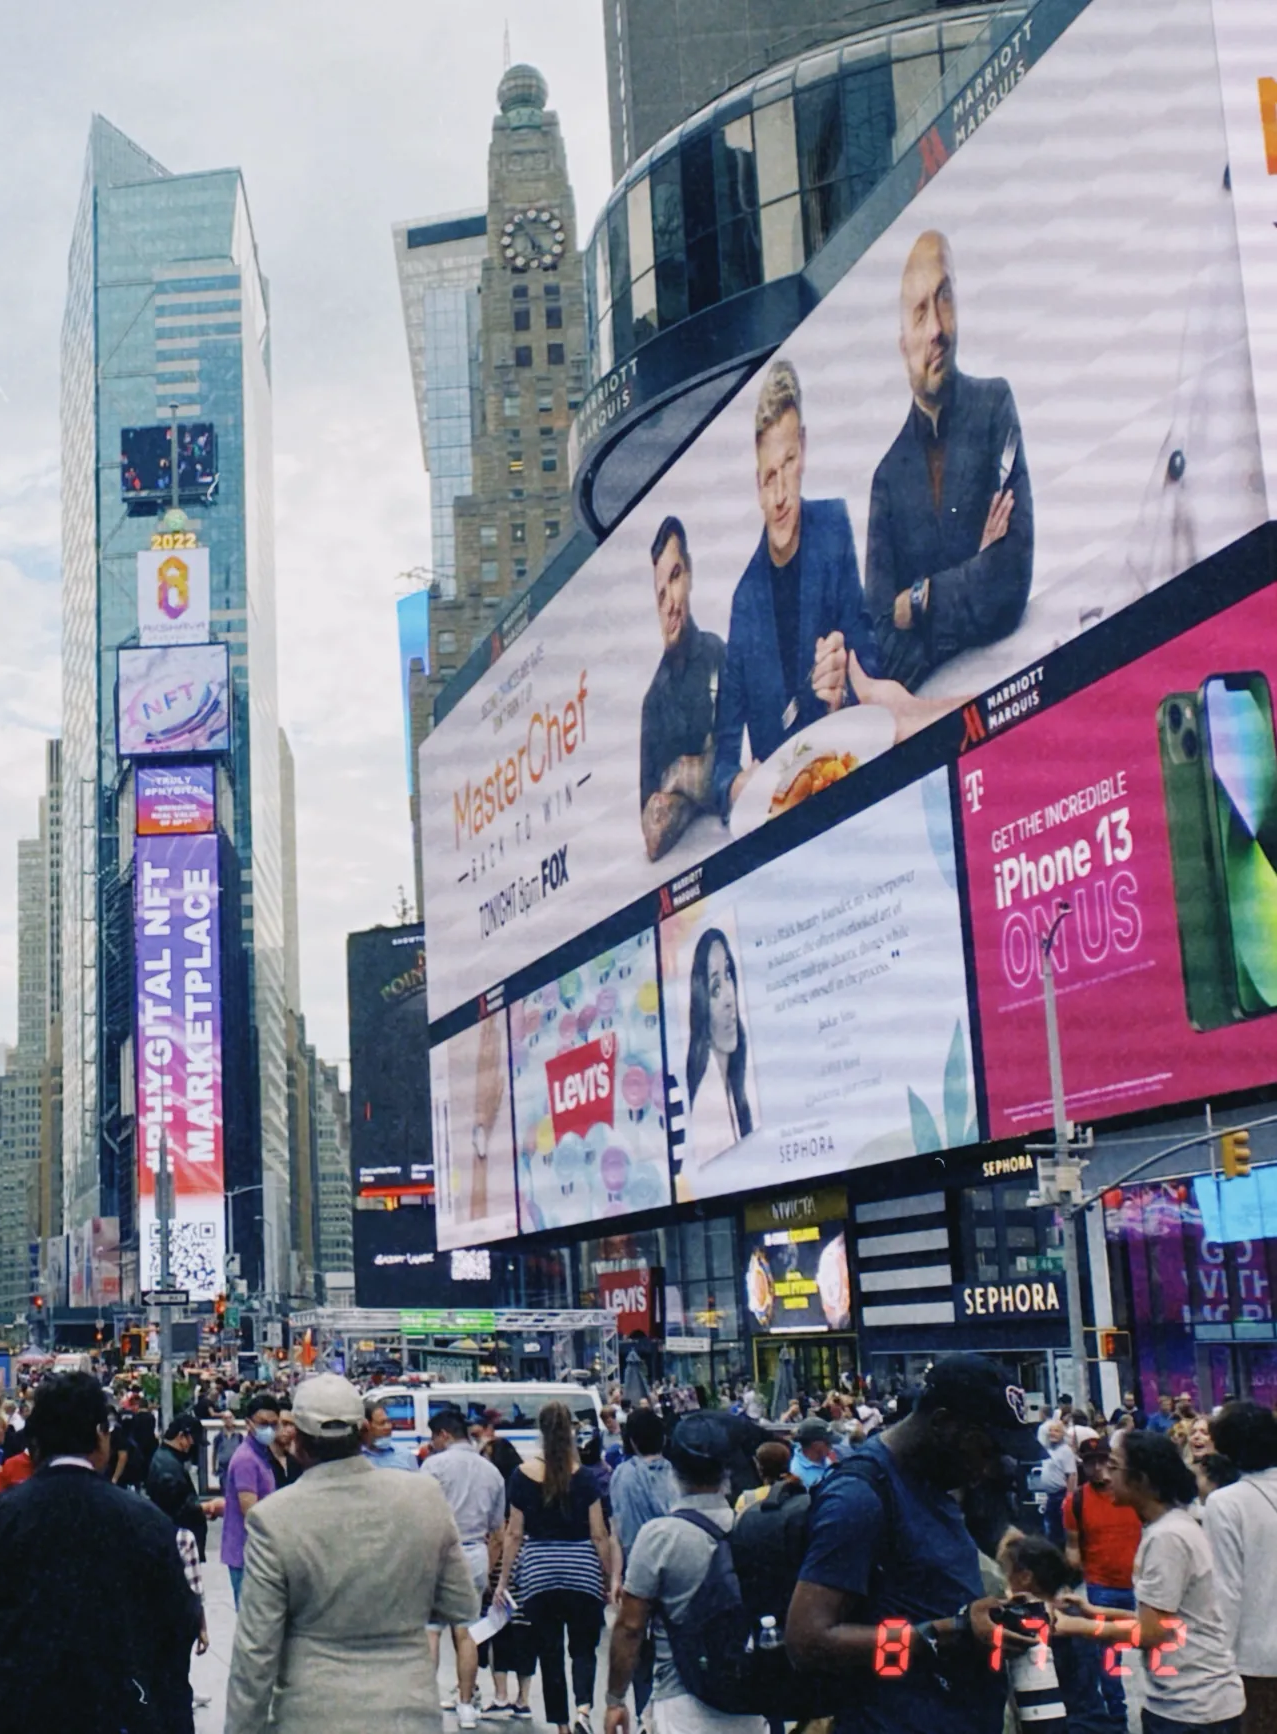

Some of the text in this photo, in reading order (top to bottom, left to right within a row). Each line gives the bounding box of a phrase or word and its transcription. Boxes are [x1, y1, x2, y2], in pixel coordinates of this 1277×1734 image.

[953, 19, 1032, 122] MARRIOTT
[955, 59, 1025, 148] MARQUIS
[151, 533, 197, 550] 2022
[143, 681, 195, 720] NFT
[987, 666, 1044, 710] MARRIOTT
[988, 691, 1040, 729] MARQUIS
[453, 668, 588, 850] MasterChef
[991, 770, 1128, 853] GET THE INCREDIBLE
[541, 843, 569, 898] FOX
[993, 807, 1133, 910] iPhone 13
[143, 861, 171, 936] NFT
[1002, 897, 1069, 989] ON
[1075, 870, 1142, 964] US
[183, 869, 215, 1162] MARKETPLACE
[779, 1136, 835, 1164] SEPHORA
[982, 1154, 1033, 1177] SEPHORA
[963, 1282, 1060, 1315] SEPHORA
